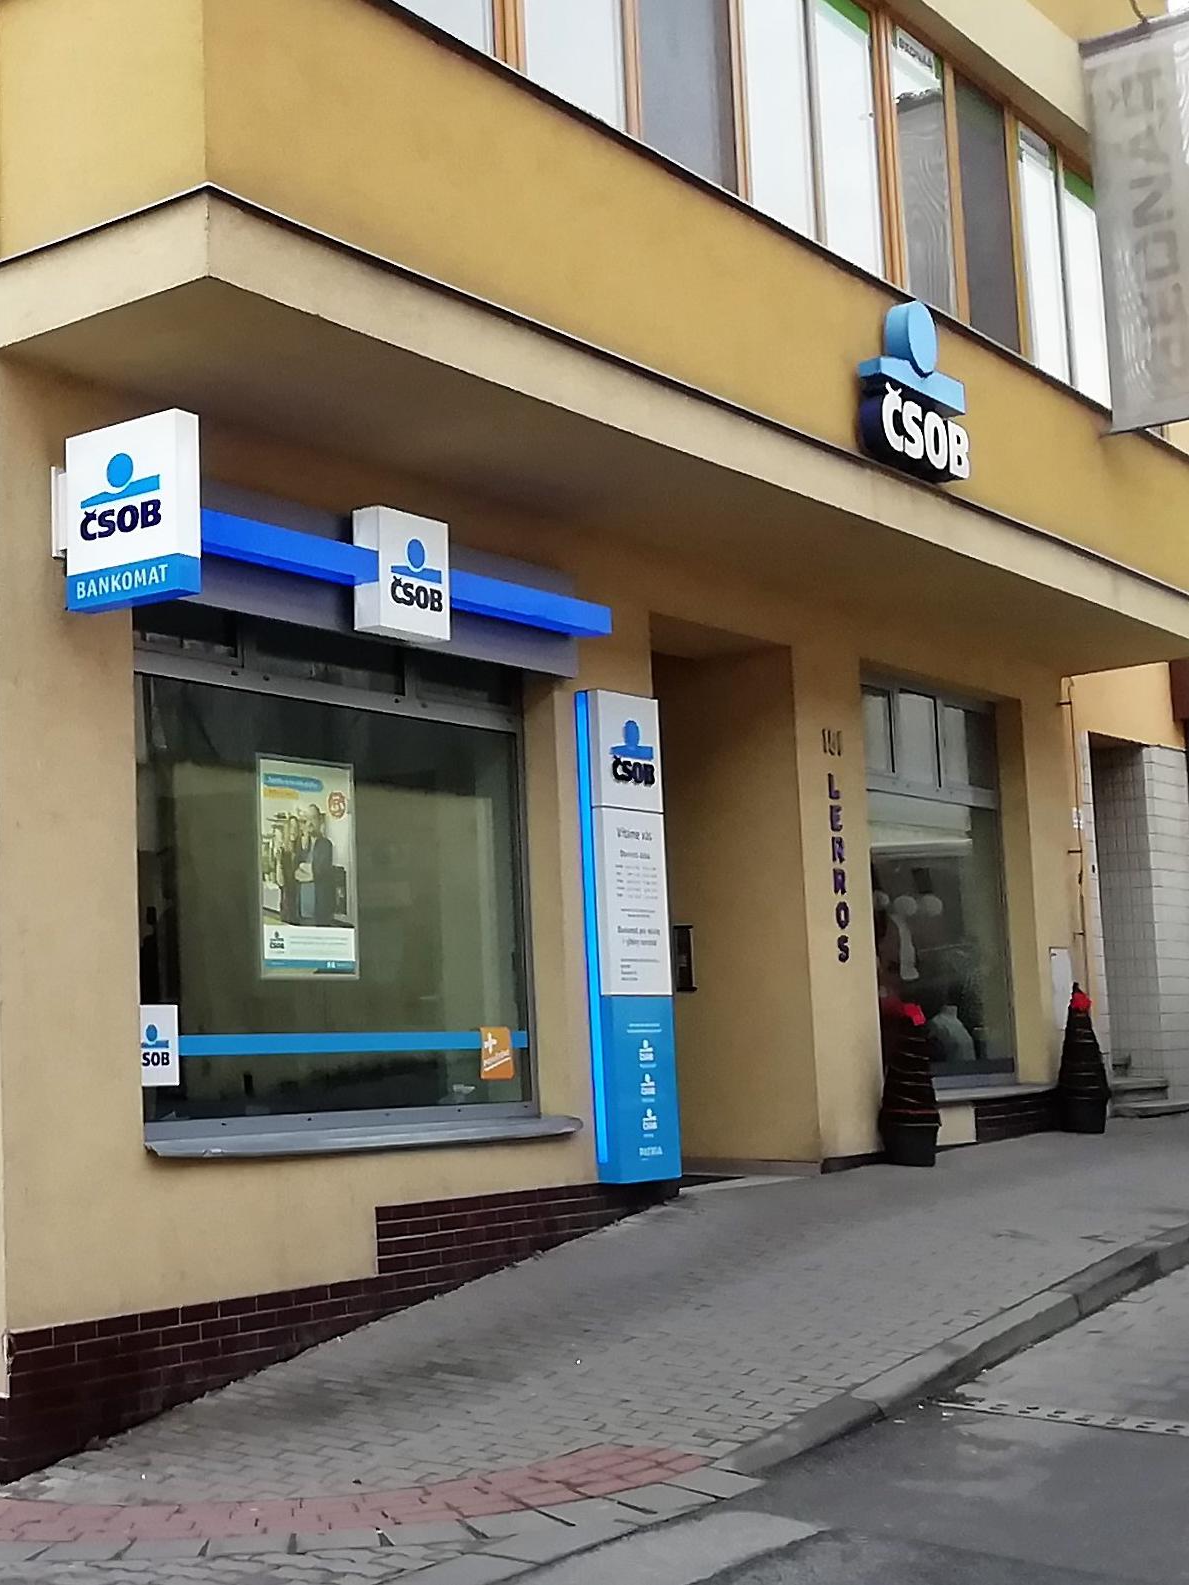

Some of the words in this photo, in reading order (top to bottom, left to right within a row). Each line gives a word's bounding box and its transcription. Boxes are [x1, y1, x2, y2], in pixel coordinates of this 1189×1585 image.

[882, 381, 970, 479] ČSOB
[80, 498, 162, 541] ČSOB
[76, 563, 169, 600] BANKOMAT
[390, 575, 443, 612] ČSOB
[612, 754, 656, 786] ČSOB
[827, 773, 850, 963] LERROS
[142, 1052, 170, 1067] SOB
